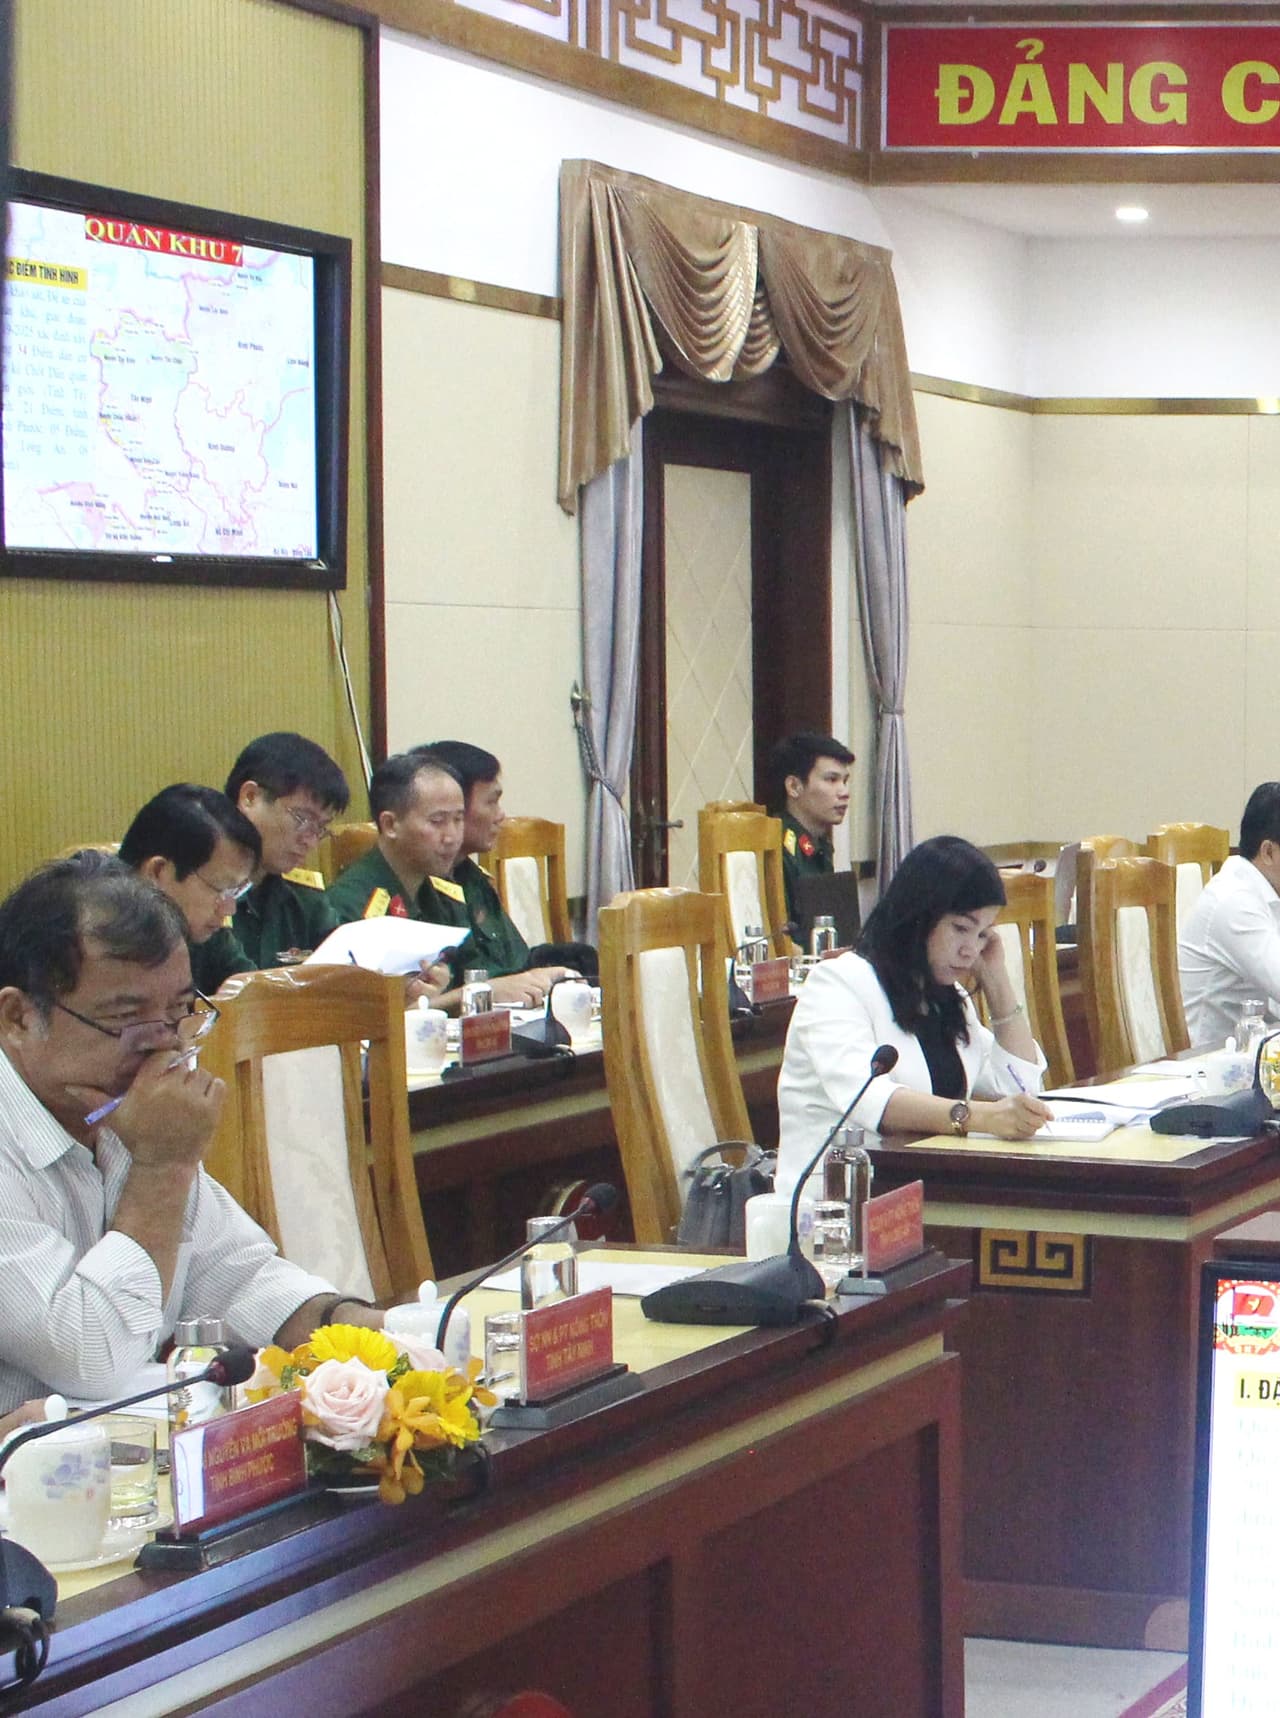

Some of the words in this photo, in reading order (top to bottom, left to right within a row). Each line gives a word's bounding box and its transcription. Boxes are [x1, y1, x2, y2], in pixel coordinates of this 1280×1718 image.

[935, 38, 1187, 124] ĐẢNG
[169, 232, 227, 260] KHU
[232, 244, 243, 264] 7
[1240, 1378, 1251, 1399] I.
